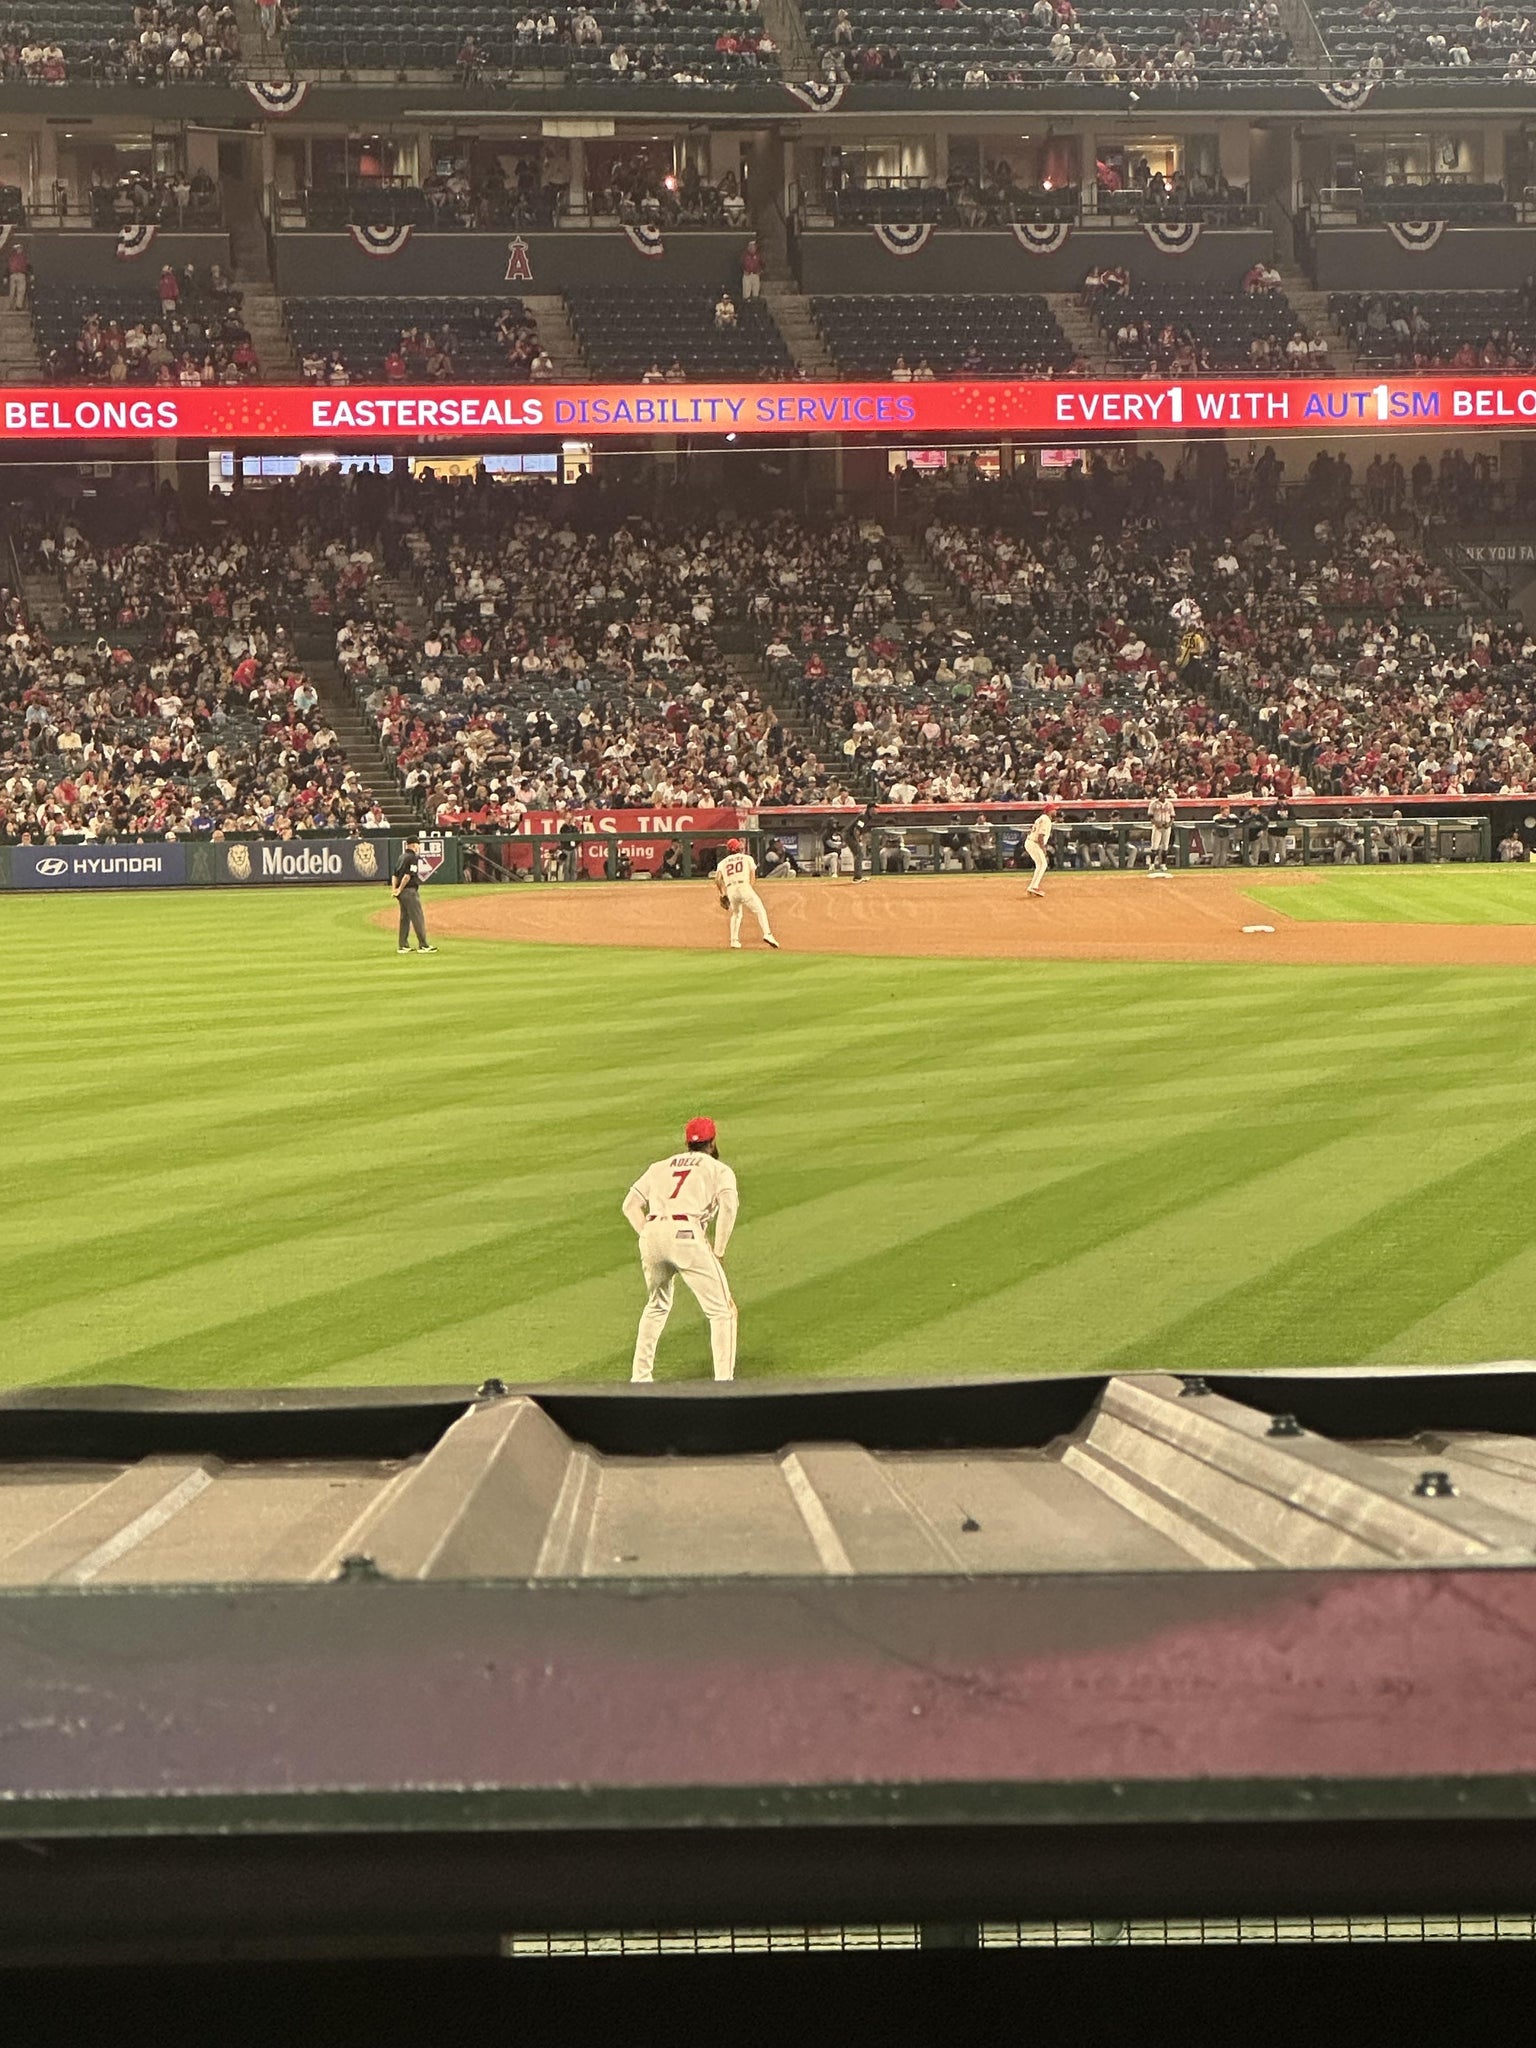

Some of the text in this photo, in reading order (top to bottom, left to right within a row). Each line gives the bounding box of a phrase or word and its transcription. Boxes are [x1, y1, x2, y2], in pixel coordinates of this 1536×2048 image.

[312, 397, 915, 427] EASTERSEALS DISABILITY SERVICES
[1056, 387, 1183, 422] EVERY1
[1196, 392, 1289, 419] WITH
[1304, 385, 1440, 420] AUT1SM
[5, 402, 178, 428] BELONGS
[1488, 546, 1517, 561] YOU
[637, 814, 694, 833] INC
[262, 847, 343, 875] Modelo
[589, 845, 655, 859] Clening
[73, 857, 162, 874] HYUNDAI
[726, 861, 743, 876] 20
[669, 1169, 691, 1199] 7
